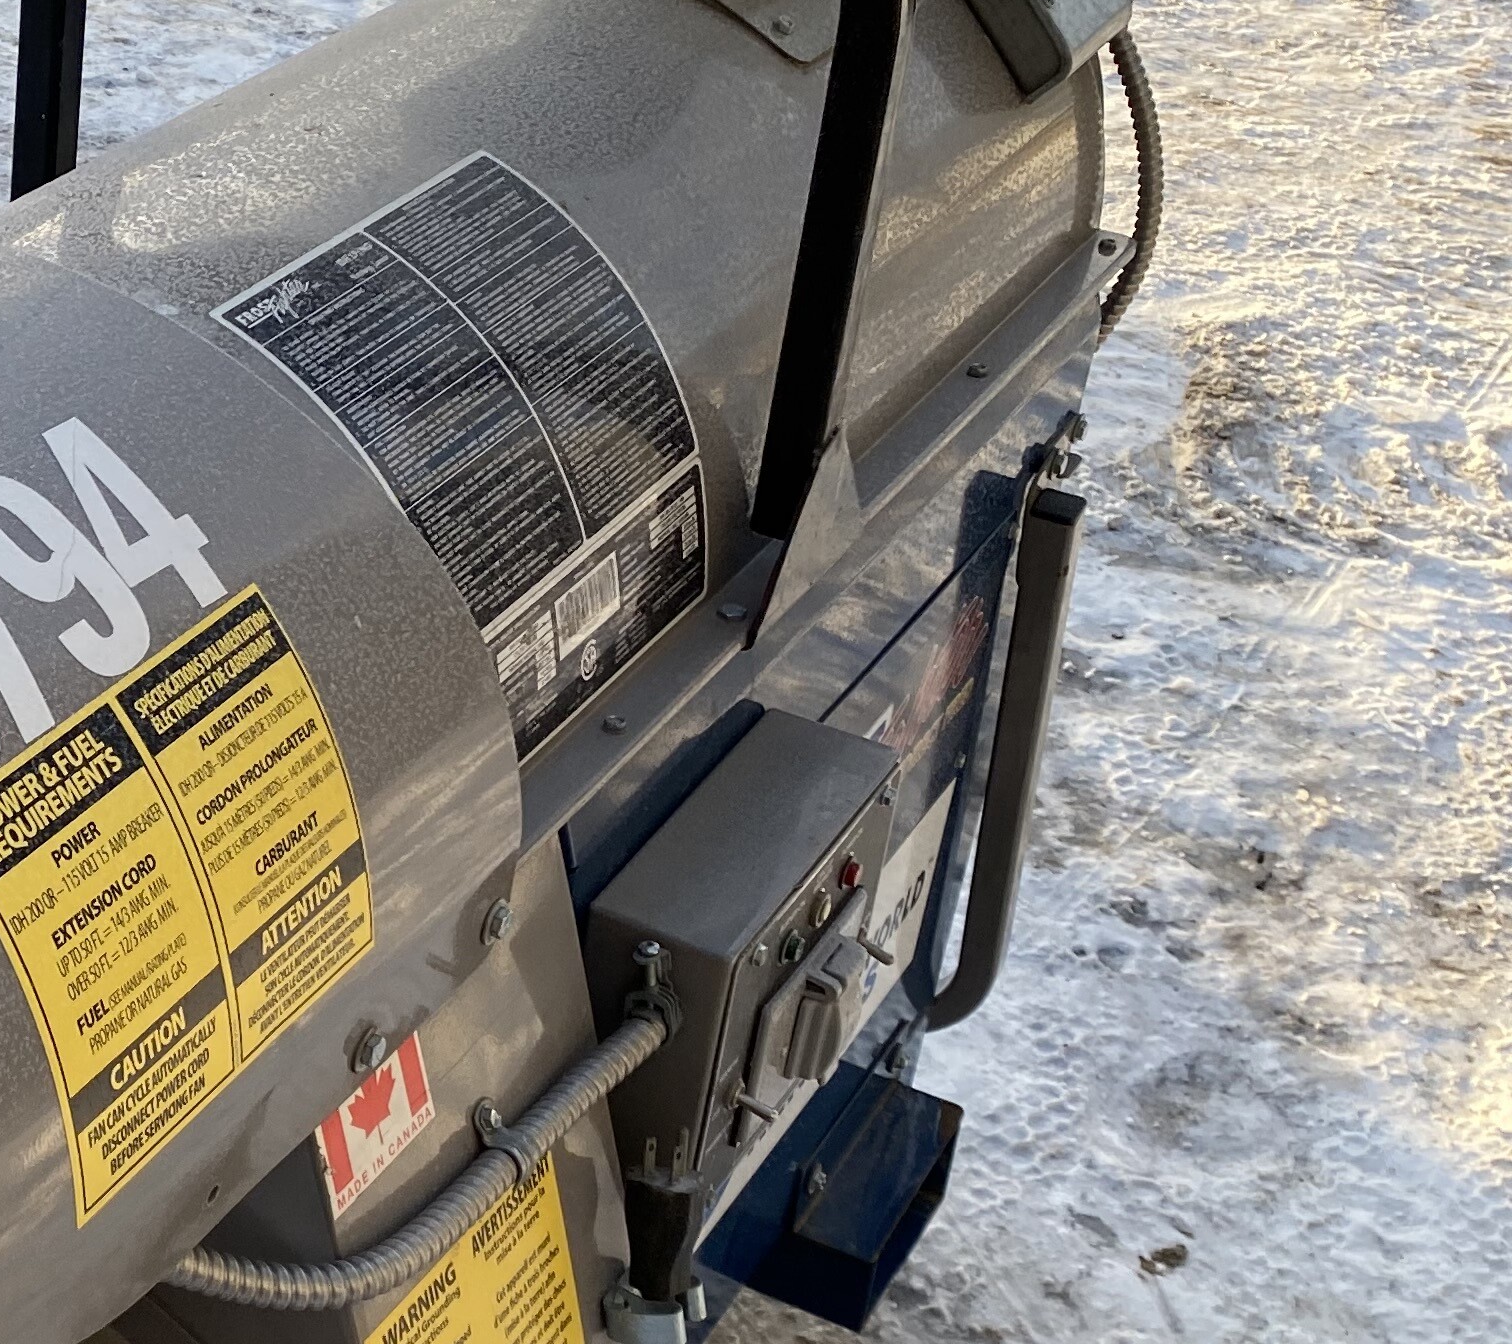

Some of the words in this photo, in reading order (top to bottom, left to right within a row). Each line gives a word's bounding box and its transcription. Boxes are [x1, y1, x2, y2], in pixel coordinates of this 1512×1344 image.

[131, 653, 206, 719] SPÉCIFICATIONS
[148, 679, 208, 737] ÉLECTRIQUE
[200, 675, 218, 697] ET
[210, 665, 229, 689] DE
[222, 628, 278, 680] CARBURANT
[195, 681, 274, 751] ALIMENTATION
[34, 757, 61, 789] &
[51, 725, 105, 776] FUEL
[194, 778, 242, 827] CORDON
[238, 715, 318, 791] PROLONGATEUR
[8, 908, 30, 936] IDH
[24, 895, 45, 923] 200
[39, 885, 59, 913] QR
[61, 867, 81, 894] 115
[75, 851, 101, 882] VOLT
[96, 843, 111, 866] 15
[106, 827, 131, 857] AMP
[125, 800, 165, 842] BREAKER
[50, 819, 101, 868] POWER
[253, 809, 319, 878] CARBURANT
[50, 879, 123, 950] EXTENSION
[120, 851, 158, 893] CORD
[55, 953, 73, 978] UP
[68, 944, 83, 968] TO
[78, 936, 93, 959] 50
[110, 904, 131, 932] 14/3
[127, 888, 151, 918] AWG
[147, 871, 171, 901] MIN.
[65, 968, 91, 1002] OVER
[87, 959, 102, 984] 50
[117, 927, 140, 958] 12/3
[135, 911, 159, 942] AWG
[155, 894, 179, 926] MIN.
[259, 863, 342, 956] ATTENTION
[75, 995, 110, 1036] FUEL
[87, 1008, 129, 1055] PROPANE
[135, 970, 172, 1013] NATURAL
[169, 955, 188, 983] GAS
[108, 1004, 185, 1095] CAUTION
[87, 1117, 106, 1149] FAN
[106, 1100, 124, 1132] CAN
[125, 1076, 151, 1114] CYCLE
[150, 1015, 217, 1090] AUTOMATICALLY
[101, 1096, 155, 1160] DISCONNECT
[155, 1066, 187, 1109] POWER
[187, 1045, 210, 1080] CORD
[109, 1130, 143, 1176] BEFORE
[144, 1088, 188, 1144] SERVICING
[188, 1072, 205, 1101] FAN
[336, 1168, 368, 1213] MADE
[372, 1152, 384, 1176] IN
[388, 1105, 431, 1159] CANADA
[469, 1153, 550, 1259] AVERTISSEMENT
[483, 1209, 523, 1262] Instructions
[522, 1191, 539, 1218] pour
[495, 1240, 512, 1266] mise
[523, 1206, 540, 1233] terre
[420, 1282, 461, 1337] Grounding
